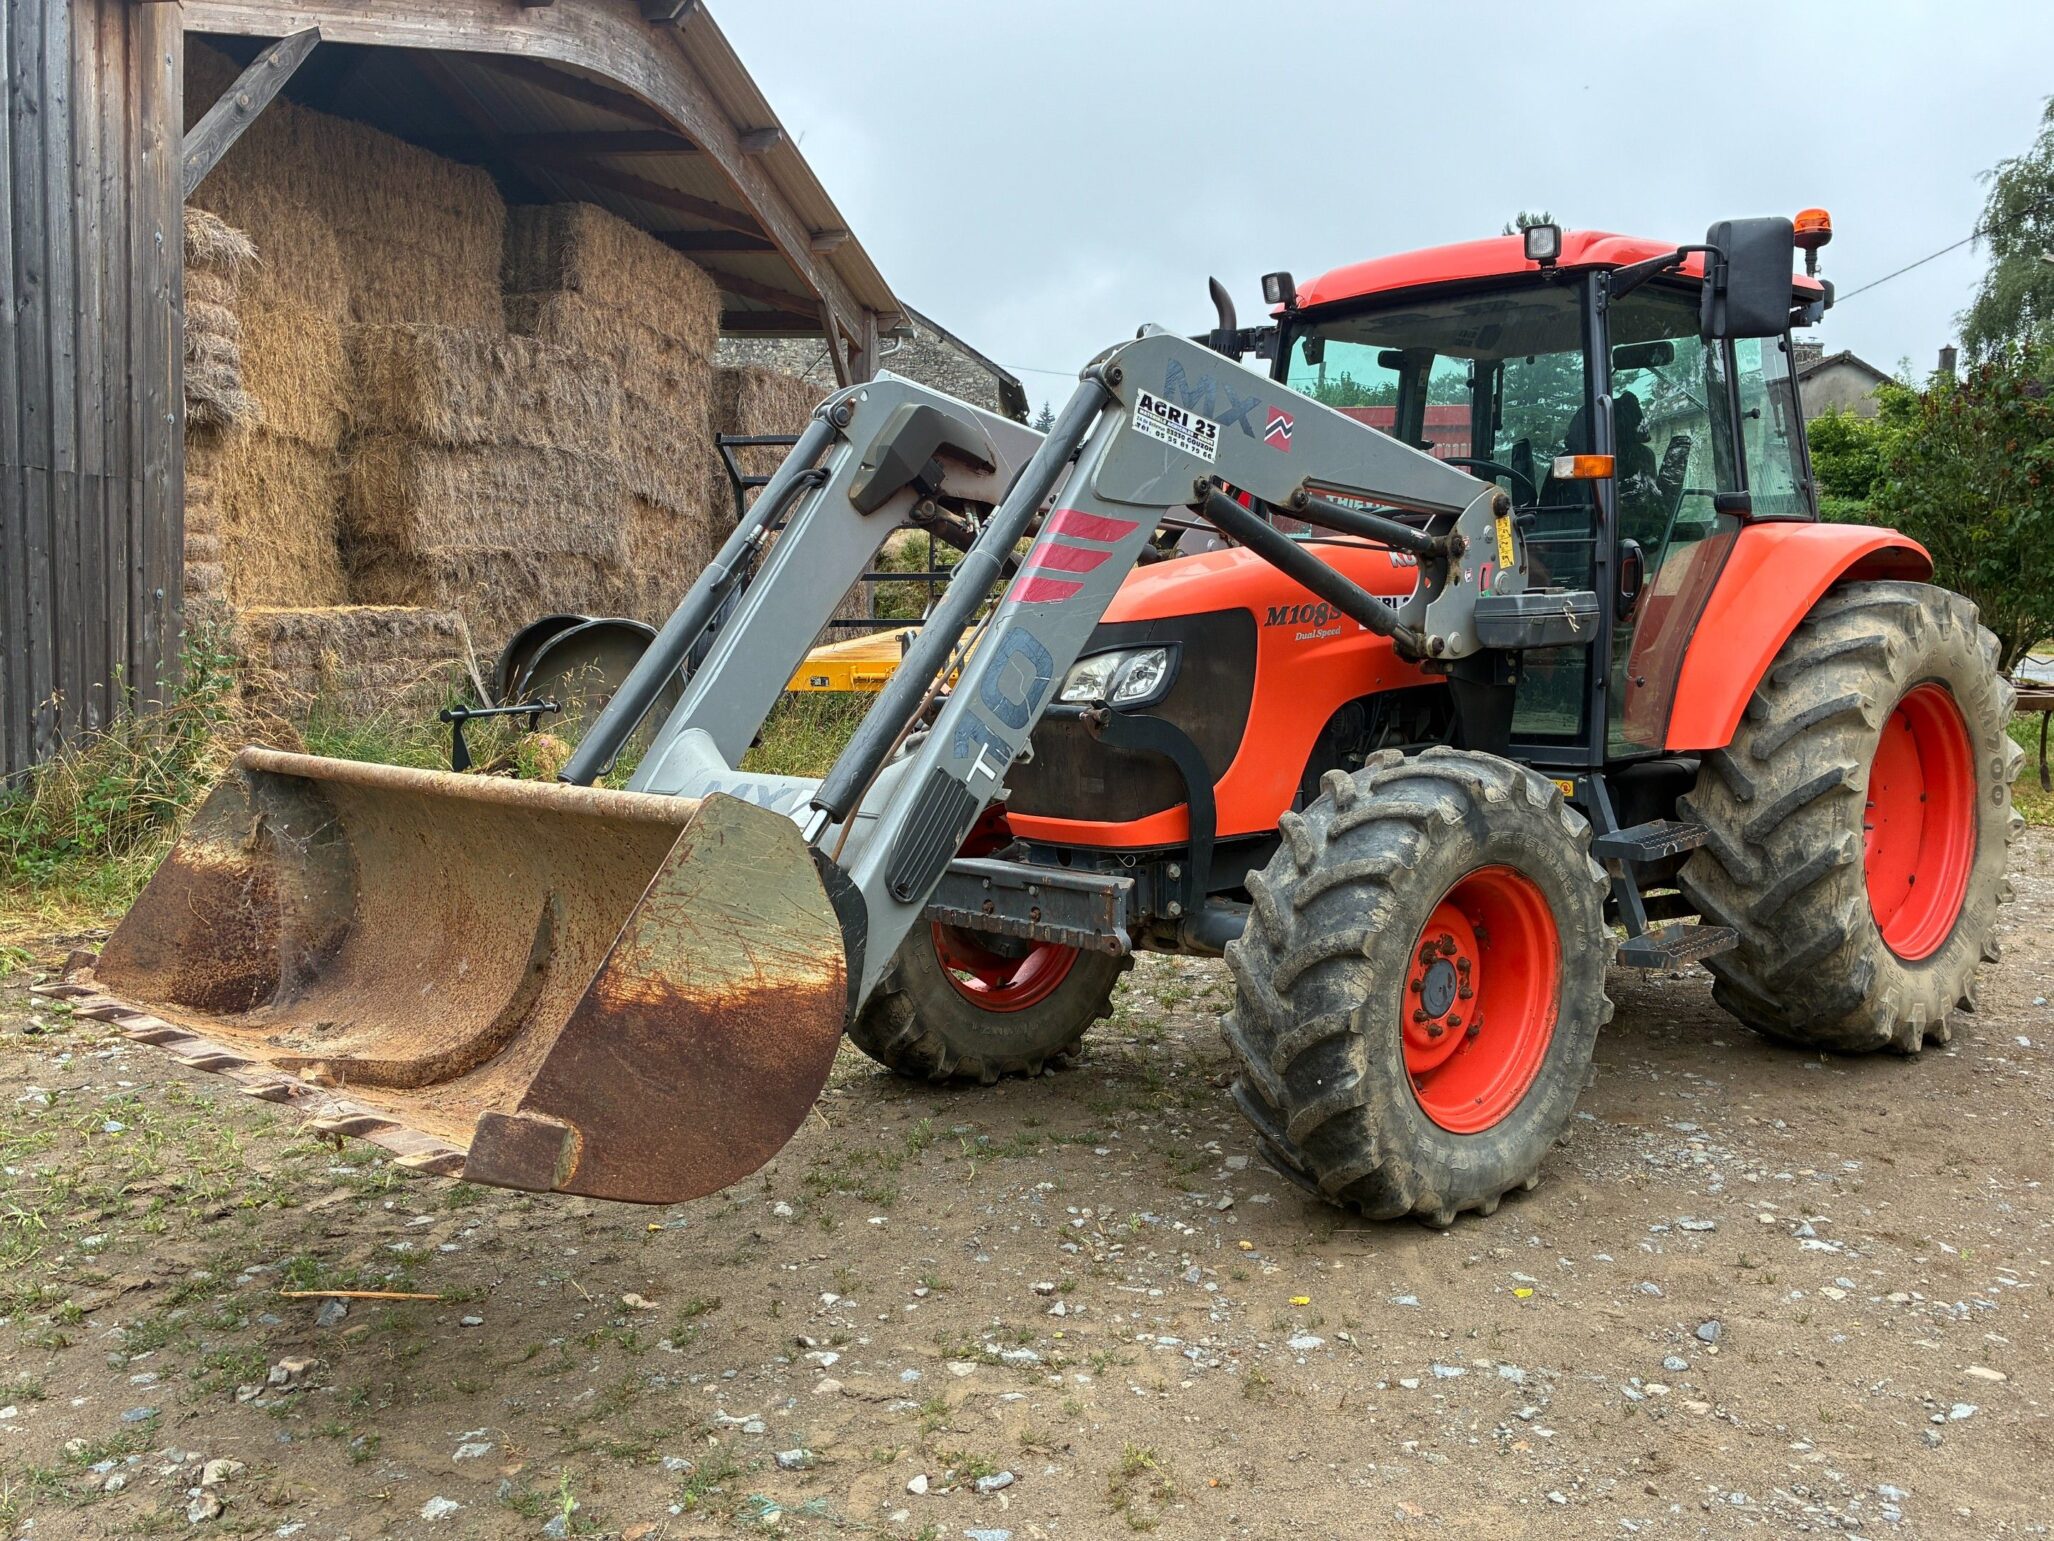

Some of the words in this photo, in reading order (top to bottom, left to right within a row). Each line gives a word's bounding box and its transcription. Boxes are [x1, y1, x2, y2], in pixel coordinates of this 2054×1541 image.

[1140, 394, 1188, 427] AGRI
[1195, 418, 1216, 439] 23
[1163, 358, 1261, 439] MX
[1295, 629, 1316, 641] Dual
[1316, 626, 1342, 639] Speed
